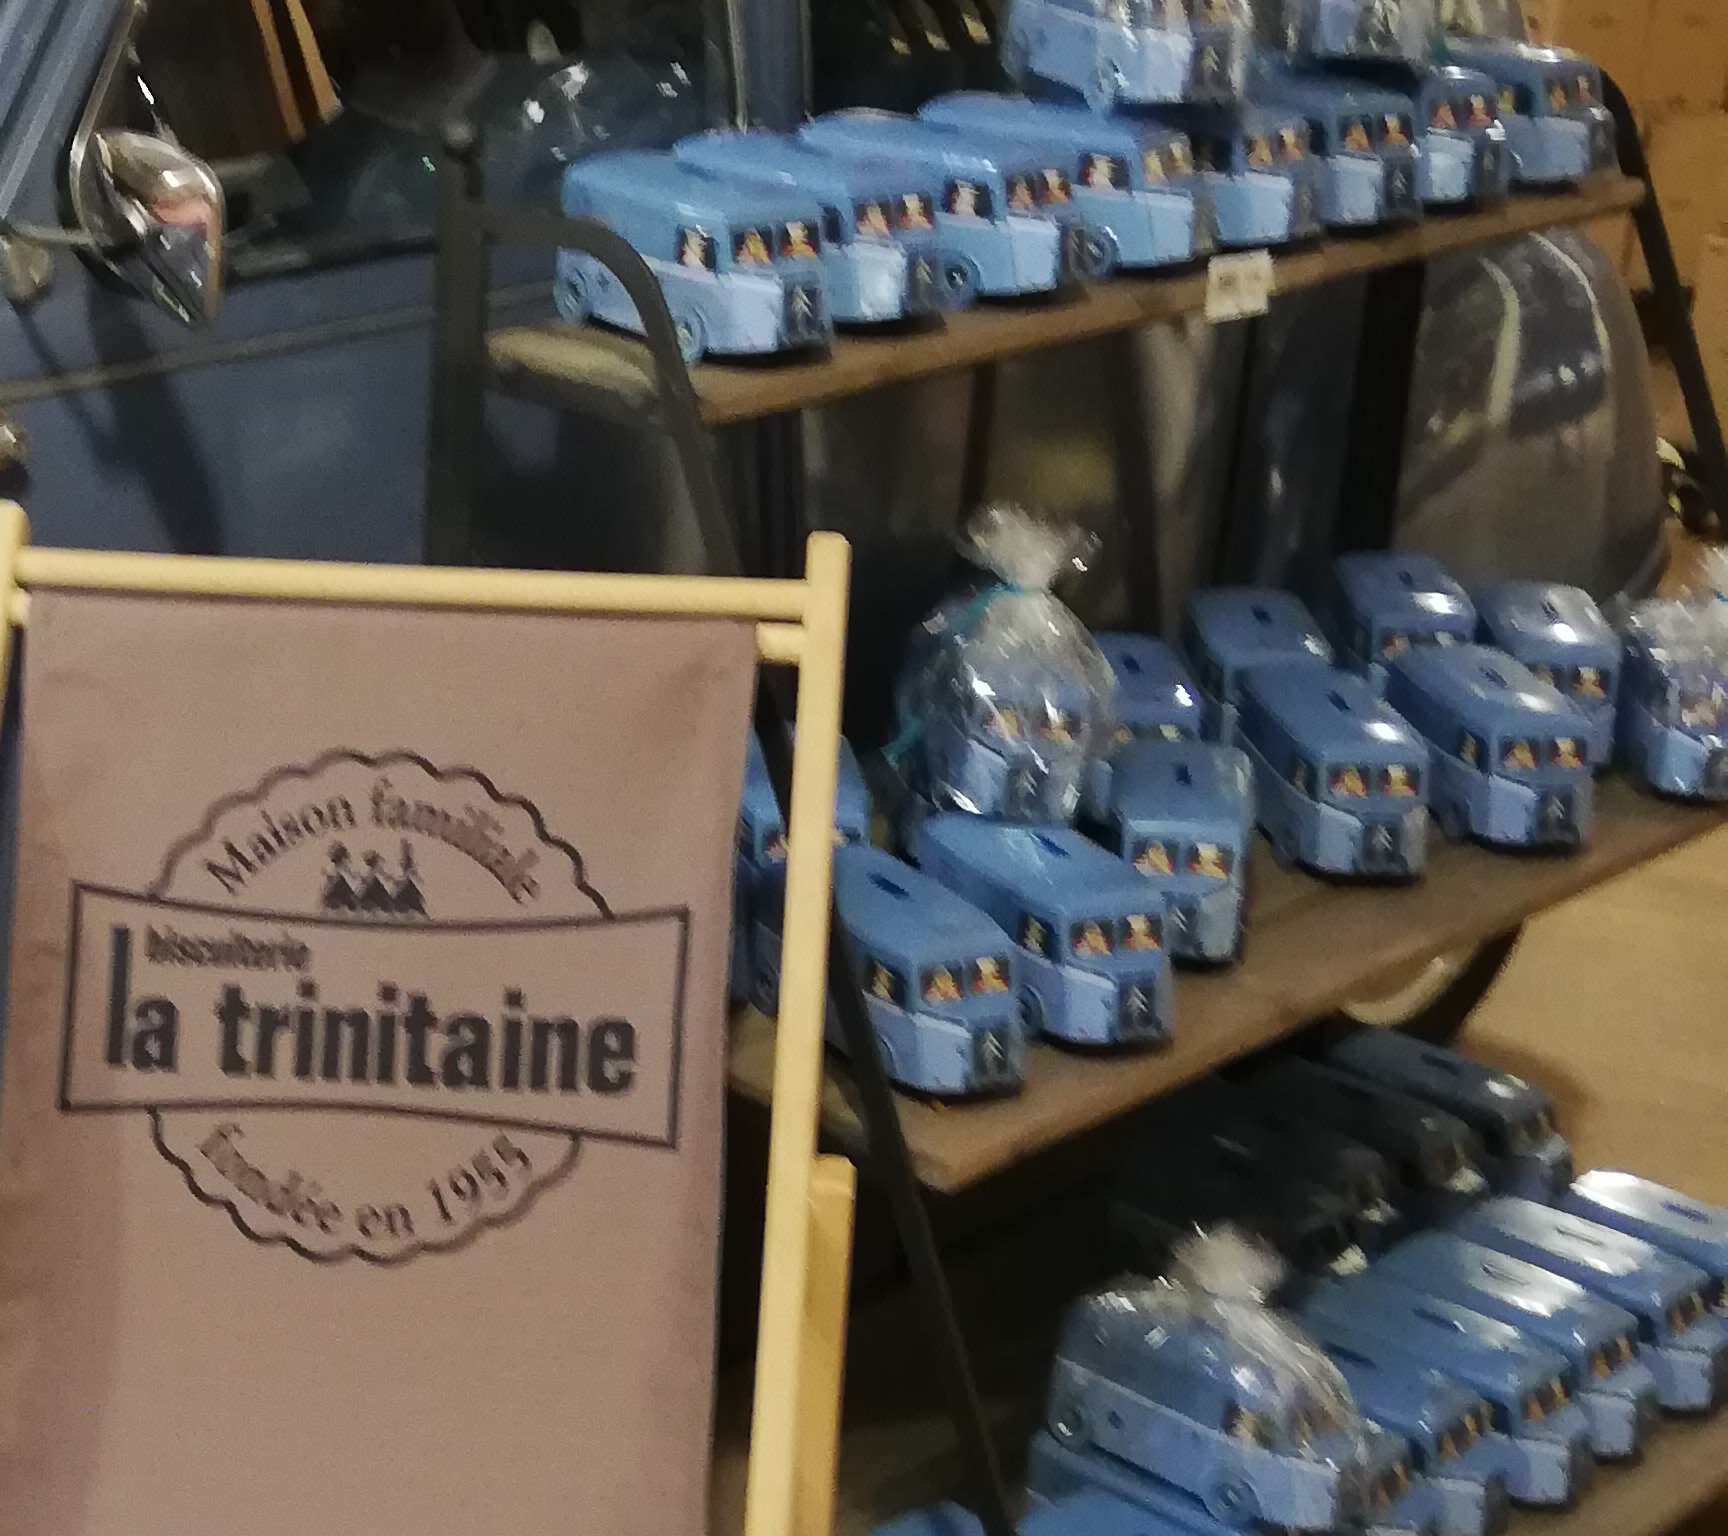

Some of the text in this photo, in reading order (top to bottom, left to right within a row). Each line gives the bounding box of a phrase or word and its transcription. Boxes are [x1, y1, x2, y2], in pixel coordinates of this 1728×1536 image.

[201, 792, 358, 897] Maison
[105, 923, 637, 1099] la trinitaine
[353, 1202, 417, 1240] en
[425, 1127, 533, 1225] 1955
